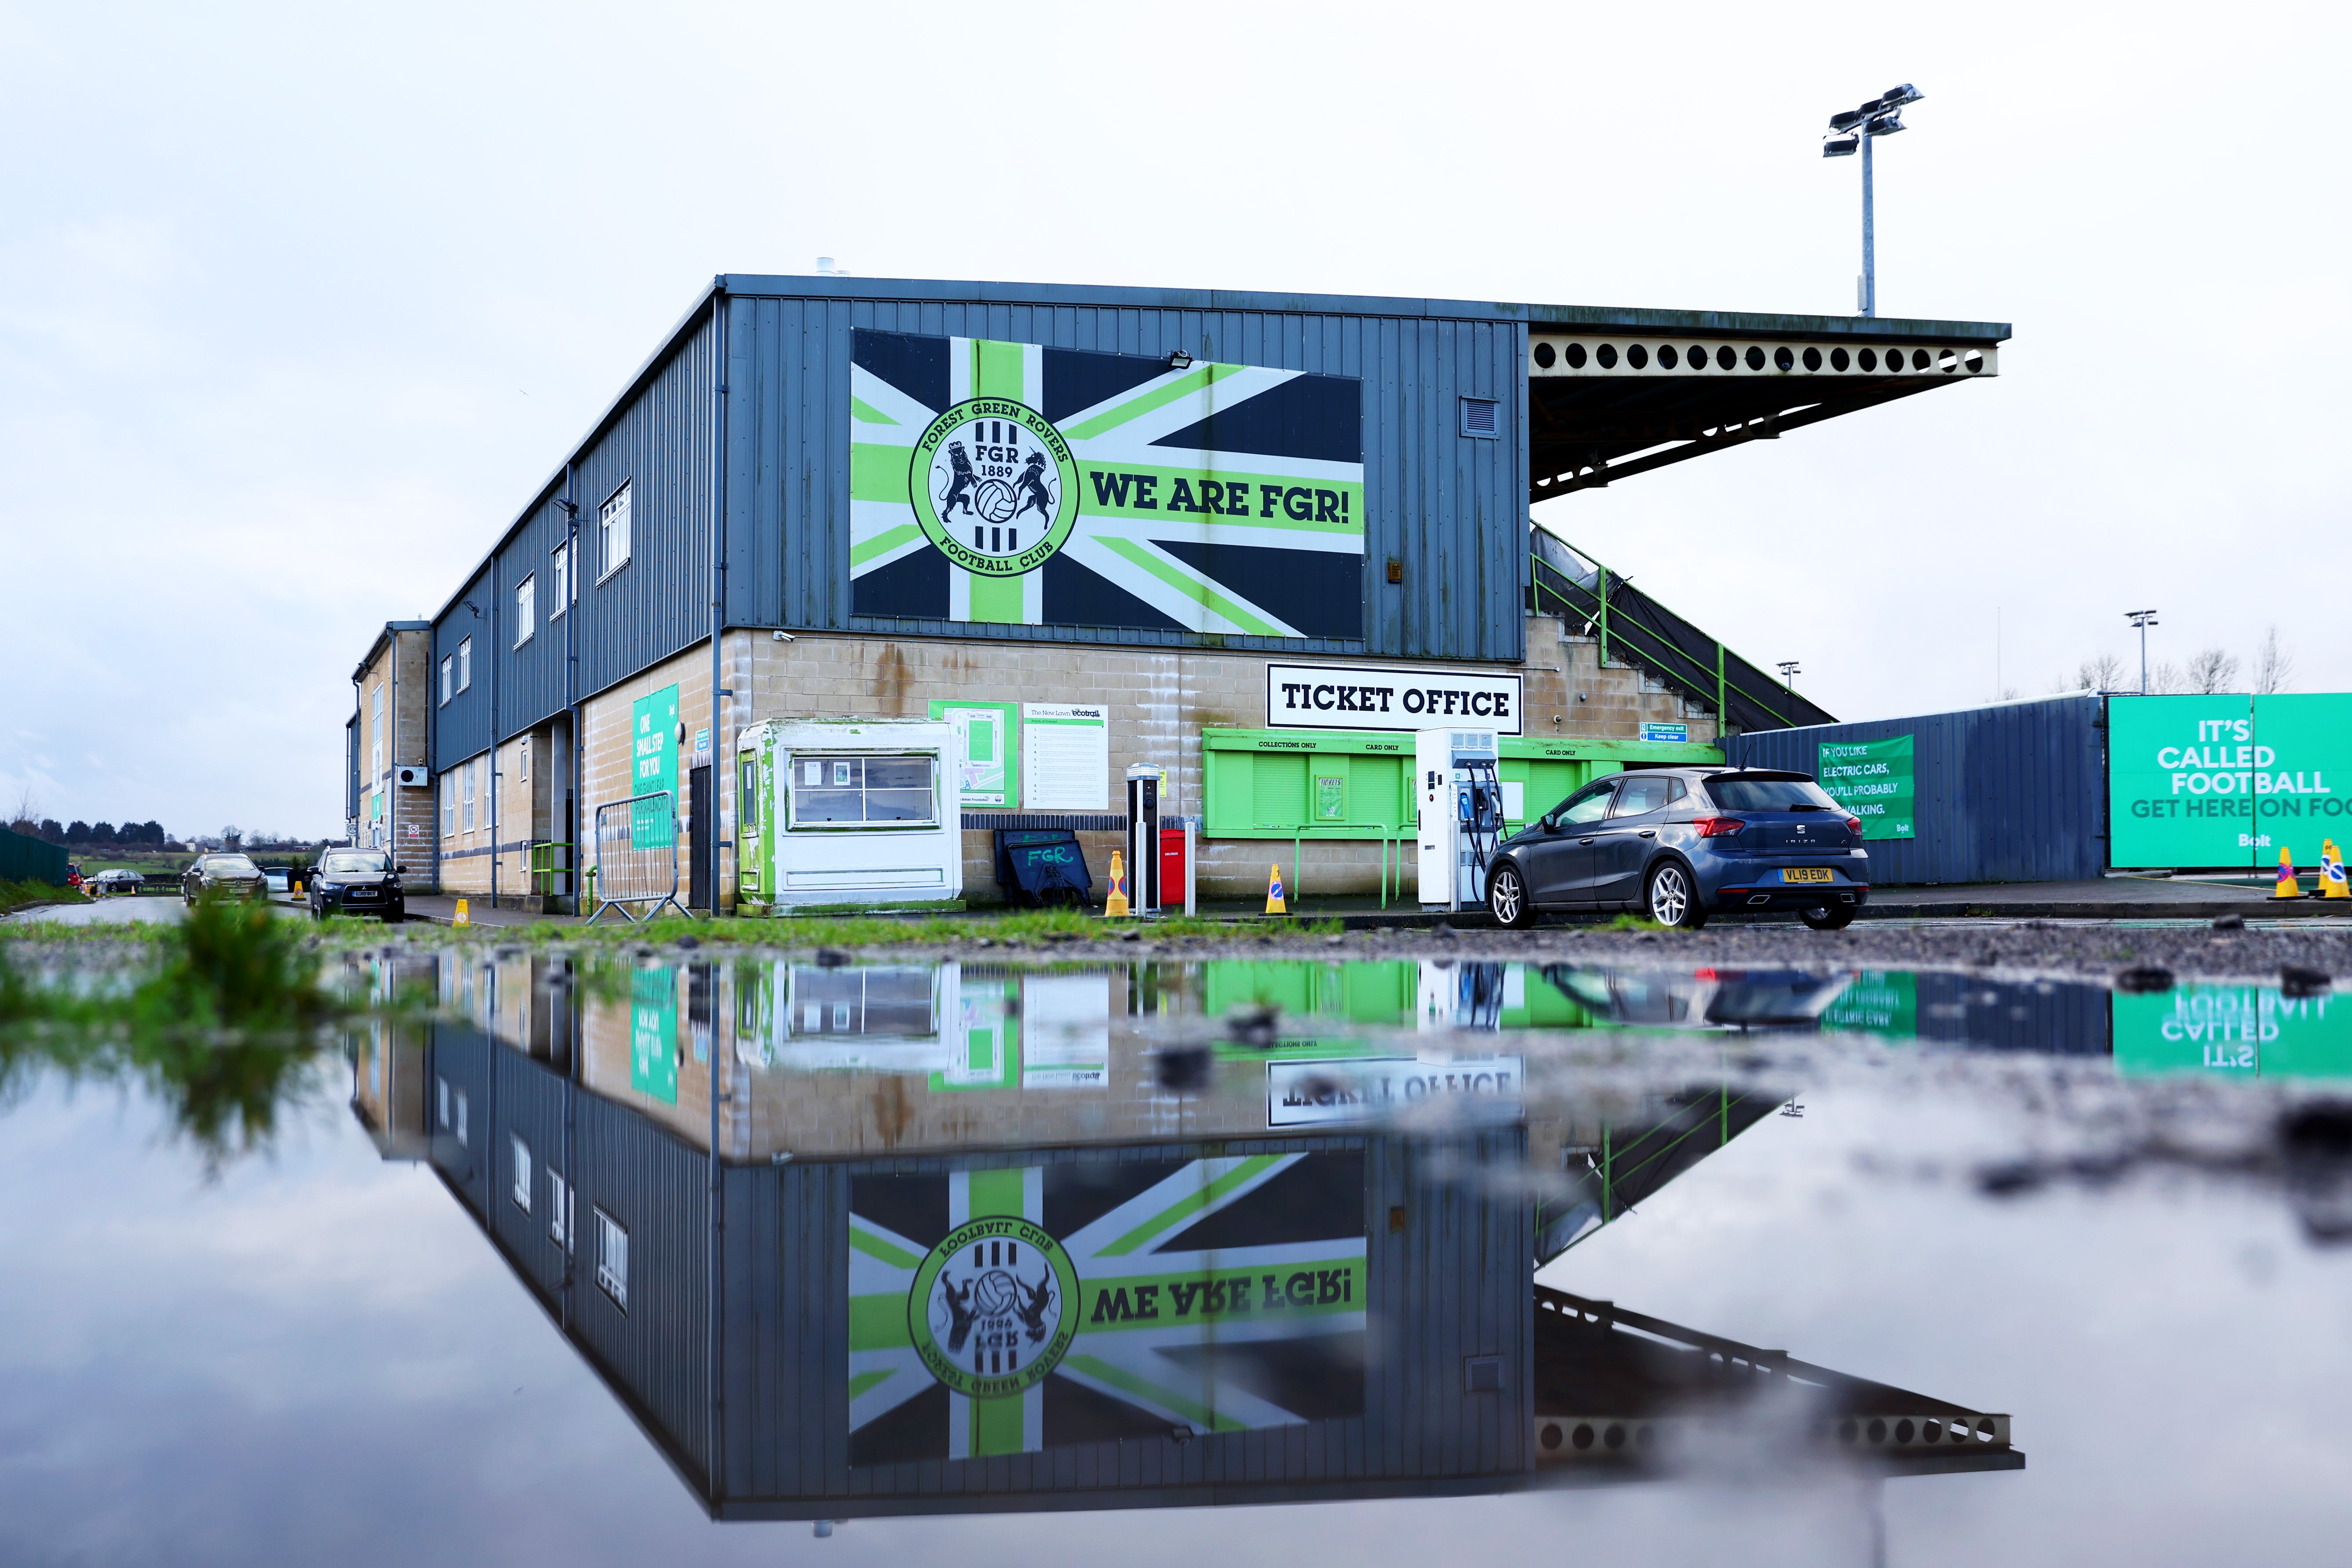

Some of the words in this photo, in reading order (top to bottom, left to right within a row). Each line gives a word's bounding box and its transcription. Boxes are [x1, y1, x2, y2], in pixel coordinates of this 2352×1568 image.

[922, 408, 964, 452] FOREST
[971, 403, 1020, 418] GREEN
[1026, 414, 1068, 463] ROVERS
[976, 445, 1018, 463] FGR
[982, 465, 1013, 477] 1889
[1090, 471, 1157, 510] WE
[1167, 478, 1249, 516] ARE
[1260, 485, 1349, 524] FGR!
[940, 536, 1013, 571] FOOTBALL
[1020, 541, 1054, 567] CLUB
[1282, 683, 1393, 712] TICKET
[1403, 689, 1509, 717] OFFICE
[640, 713, 650, 734] ONE
[2199, 719, 2250, 742] IT'S
[637, 736, 652, 757] SMALL
[652, 732, 664, 752] STEP
[1823, 748, 1830, 758] IF
[1831, 747, 1847, 757] YOU
[1849, 746, 1867, 756] LIKE
[640, 759, 649, 778] FOR
[649, 755, 660, 775] YOU
[2157, 746, 2275, 769] CALLED
[1823, 765, 1862, 777] ELECTRIC
[1863, 763, 1889, 775] CARS,
[1823, 786, 1852, 797] YOU'LL
[1854, 783, 1898, 795] PROBABLY
[2172, 771, 2330, 795] FOOTBALL
[2131, 799, 2180, 818] GET
[2186, 798, 2251, 817] HERE
[2260, 798, 2301, 817] ON
[1896, 824, 1909, 834] Bolt
[2239, 834, 2271, 850] Bolt
[1028, 846, 1073, 866] FGR
[1786, 870, 1808, 880] VL19
[1810, 869, 1829, 880] EDK
